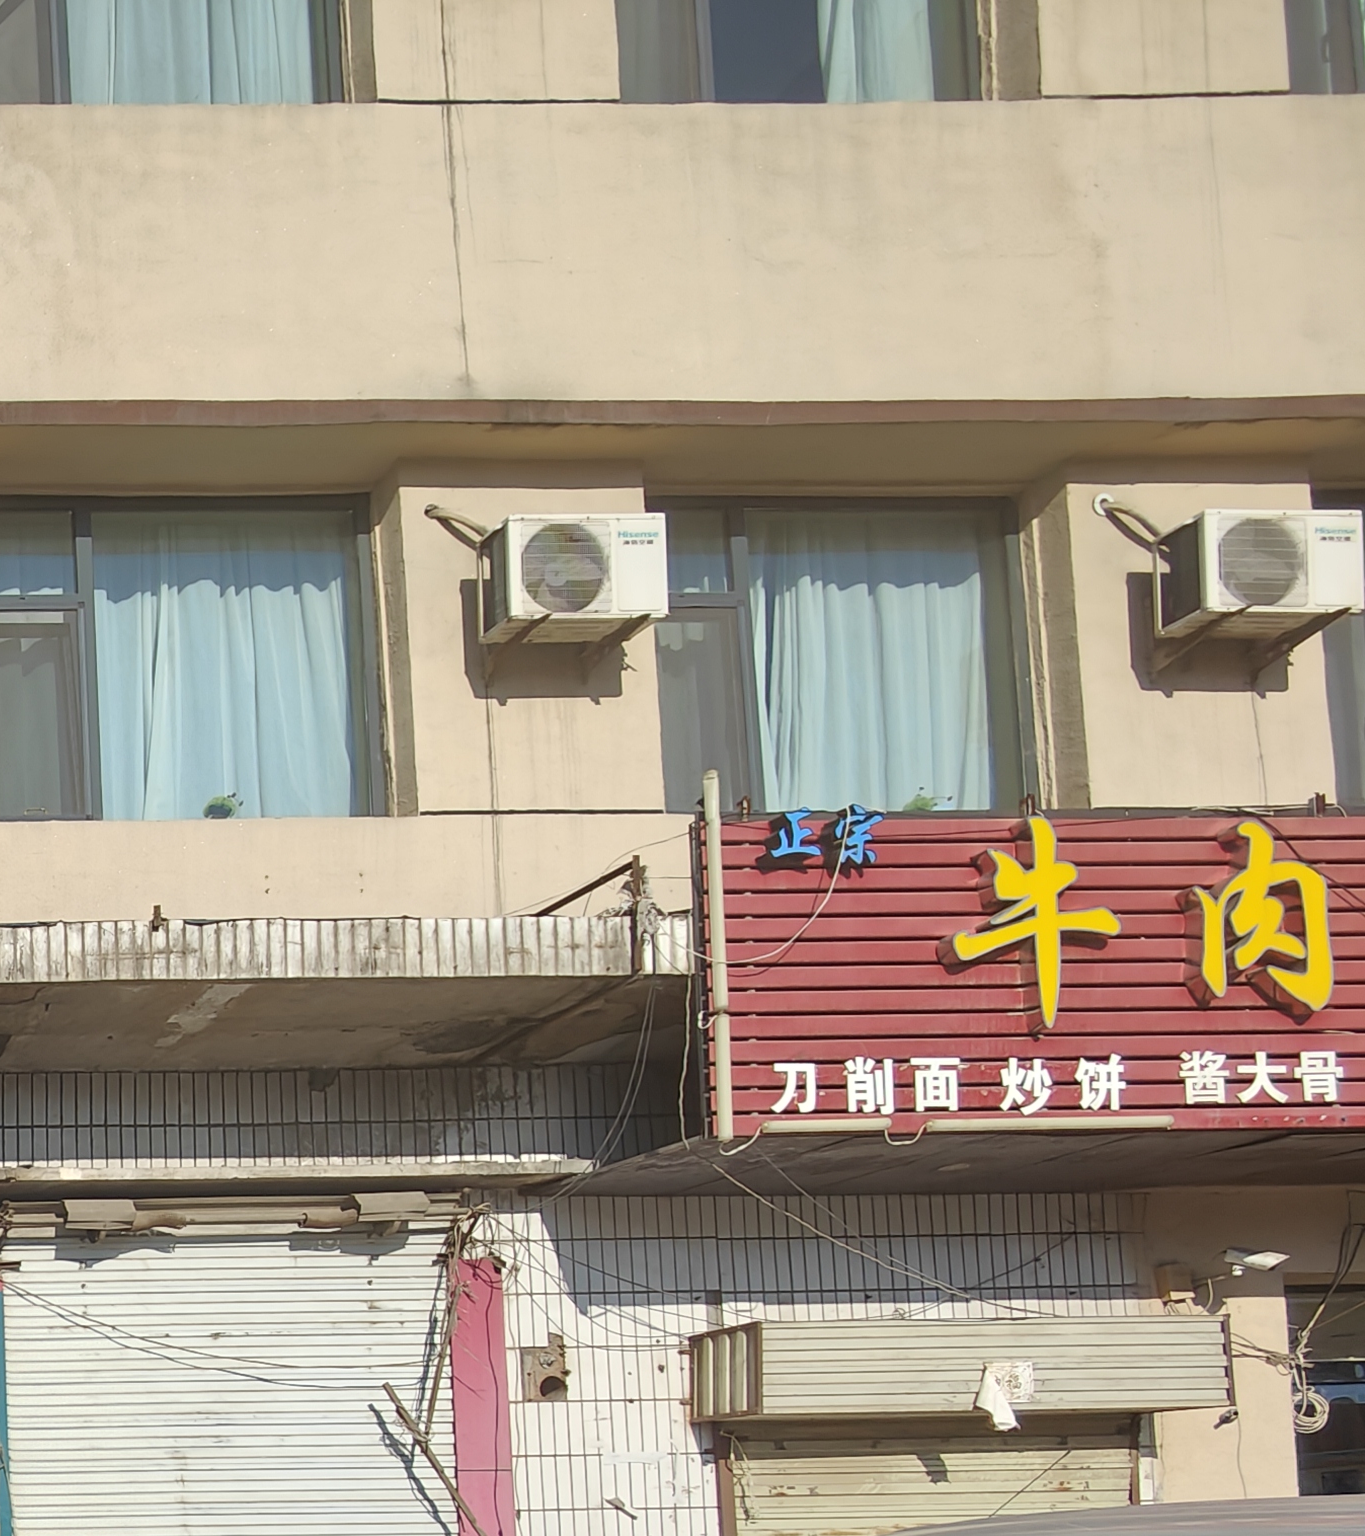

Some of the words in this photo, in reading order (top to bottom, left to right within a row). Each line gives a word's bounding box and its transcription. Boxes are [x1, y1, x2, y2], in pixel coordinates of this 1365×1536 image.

[770, 803, 883, 865] 正宗
[951, 815, 1335, 1030] 牛肉
[771, 1055, 961, 1115] 刀削面
[999, 1053, 1127, 1116] 炒饼
[1179, 1049, 1346, 1106] 酱大骨
